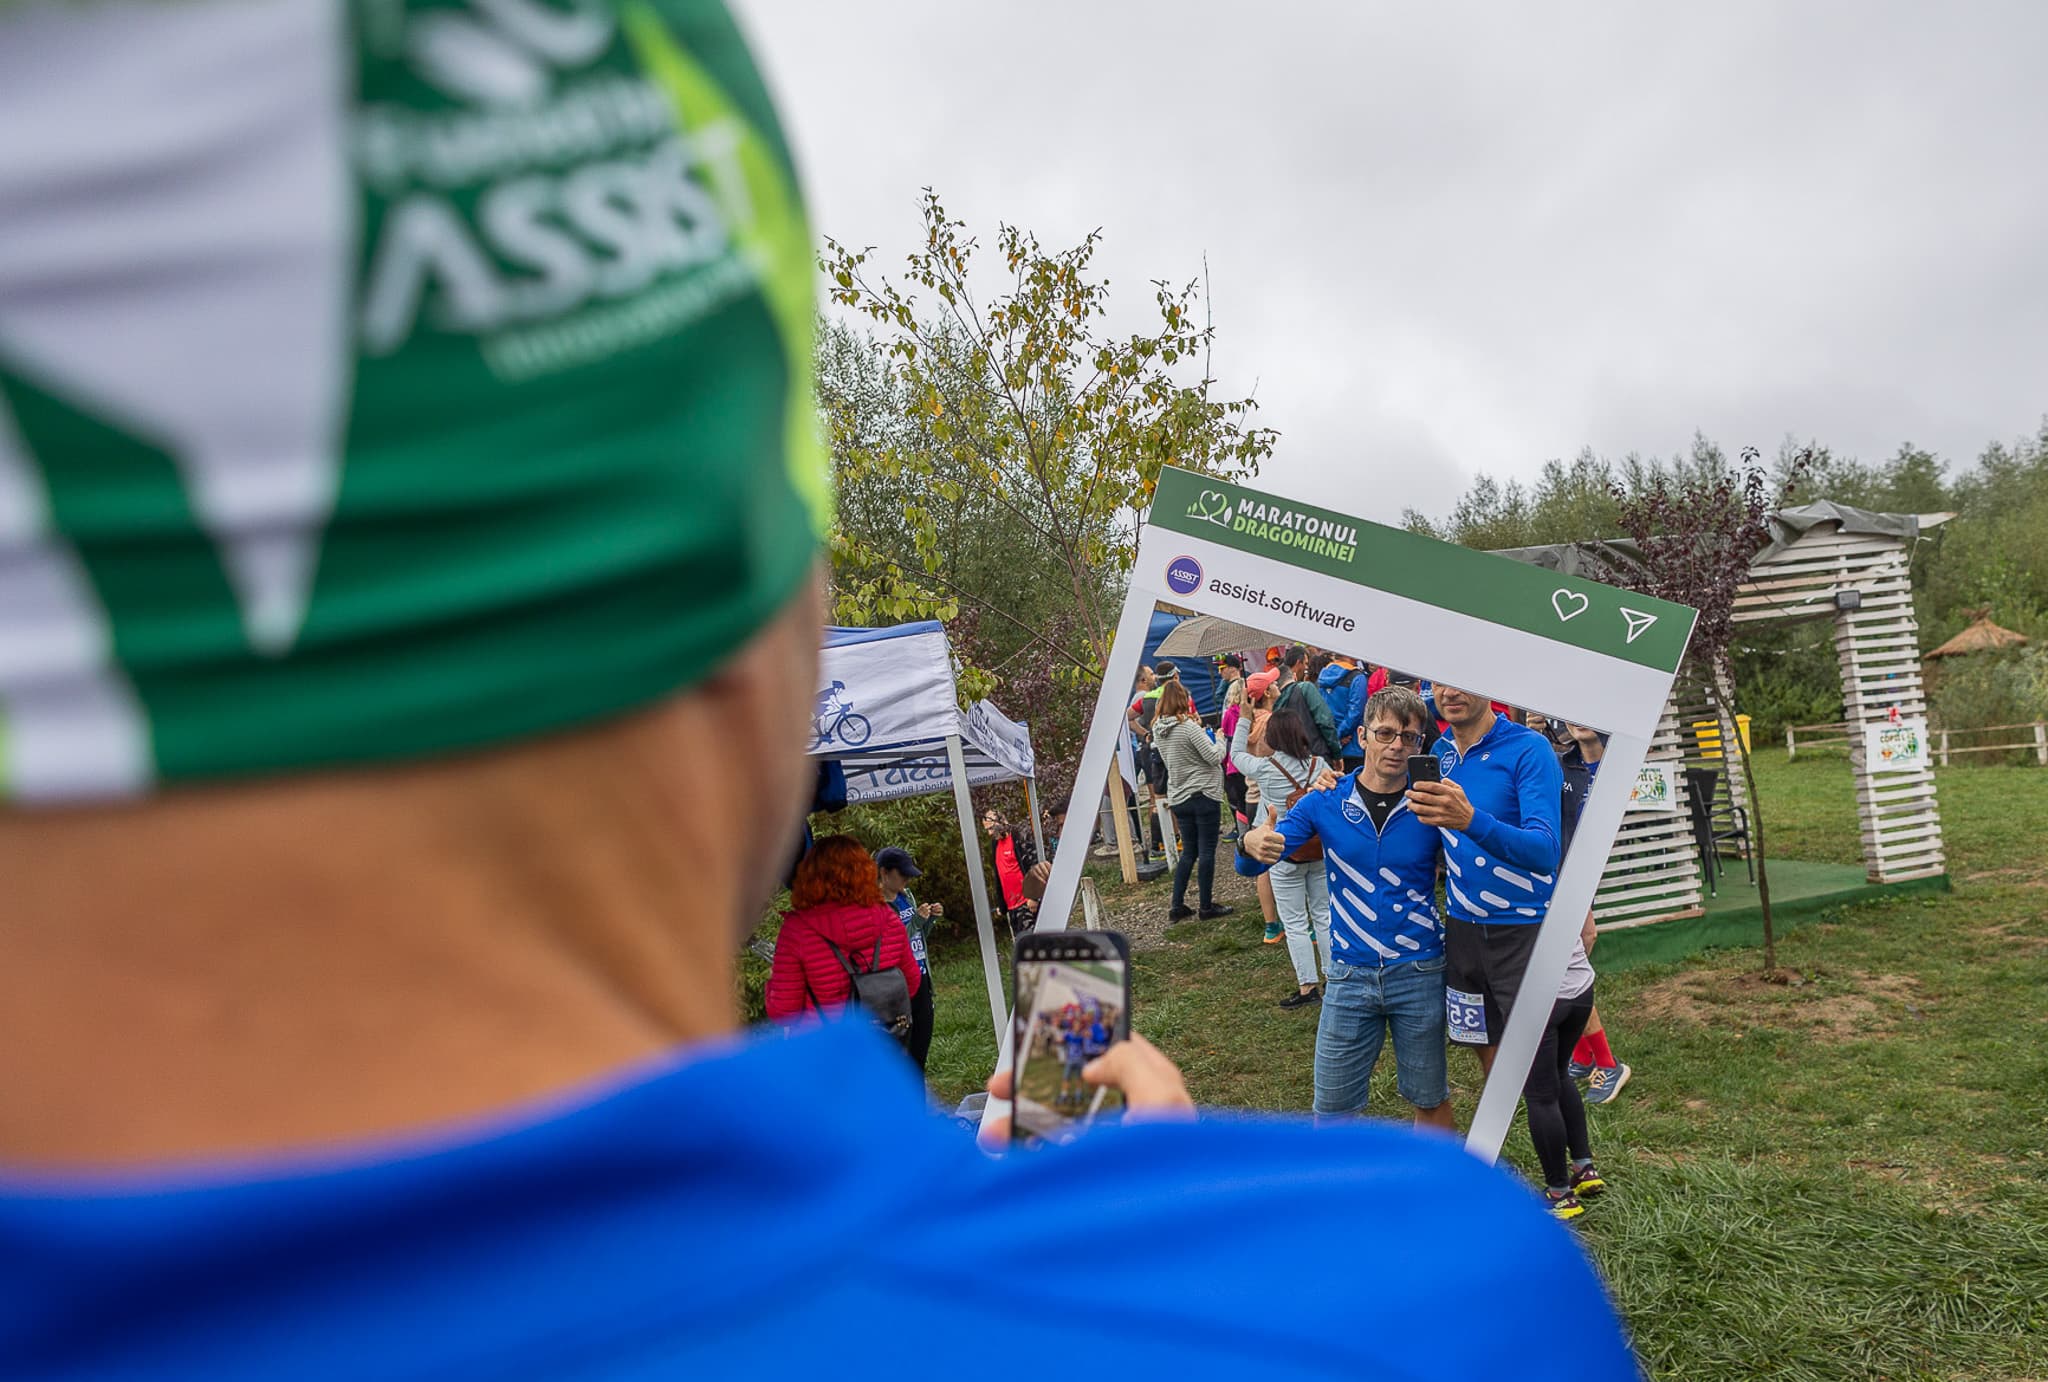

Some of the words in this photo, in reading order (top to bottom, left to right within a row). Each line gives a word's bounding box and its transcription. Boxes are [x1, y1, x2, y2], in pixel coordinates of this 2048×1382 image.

[1232, 515, 1356, 563] DRAGOMIRNEI
[1236, 498, 1358, 546] MARATONUL
[1170, 568, 1199, 582] ASSIST
[1208, 578, 1356, 632] assist.software
